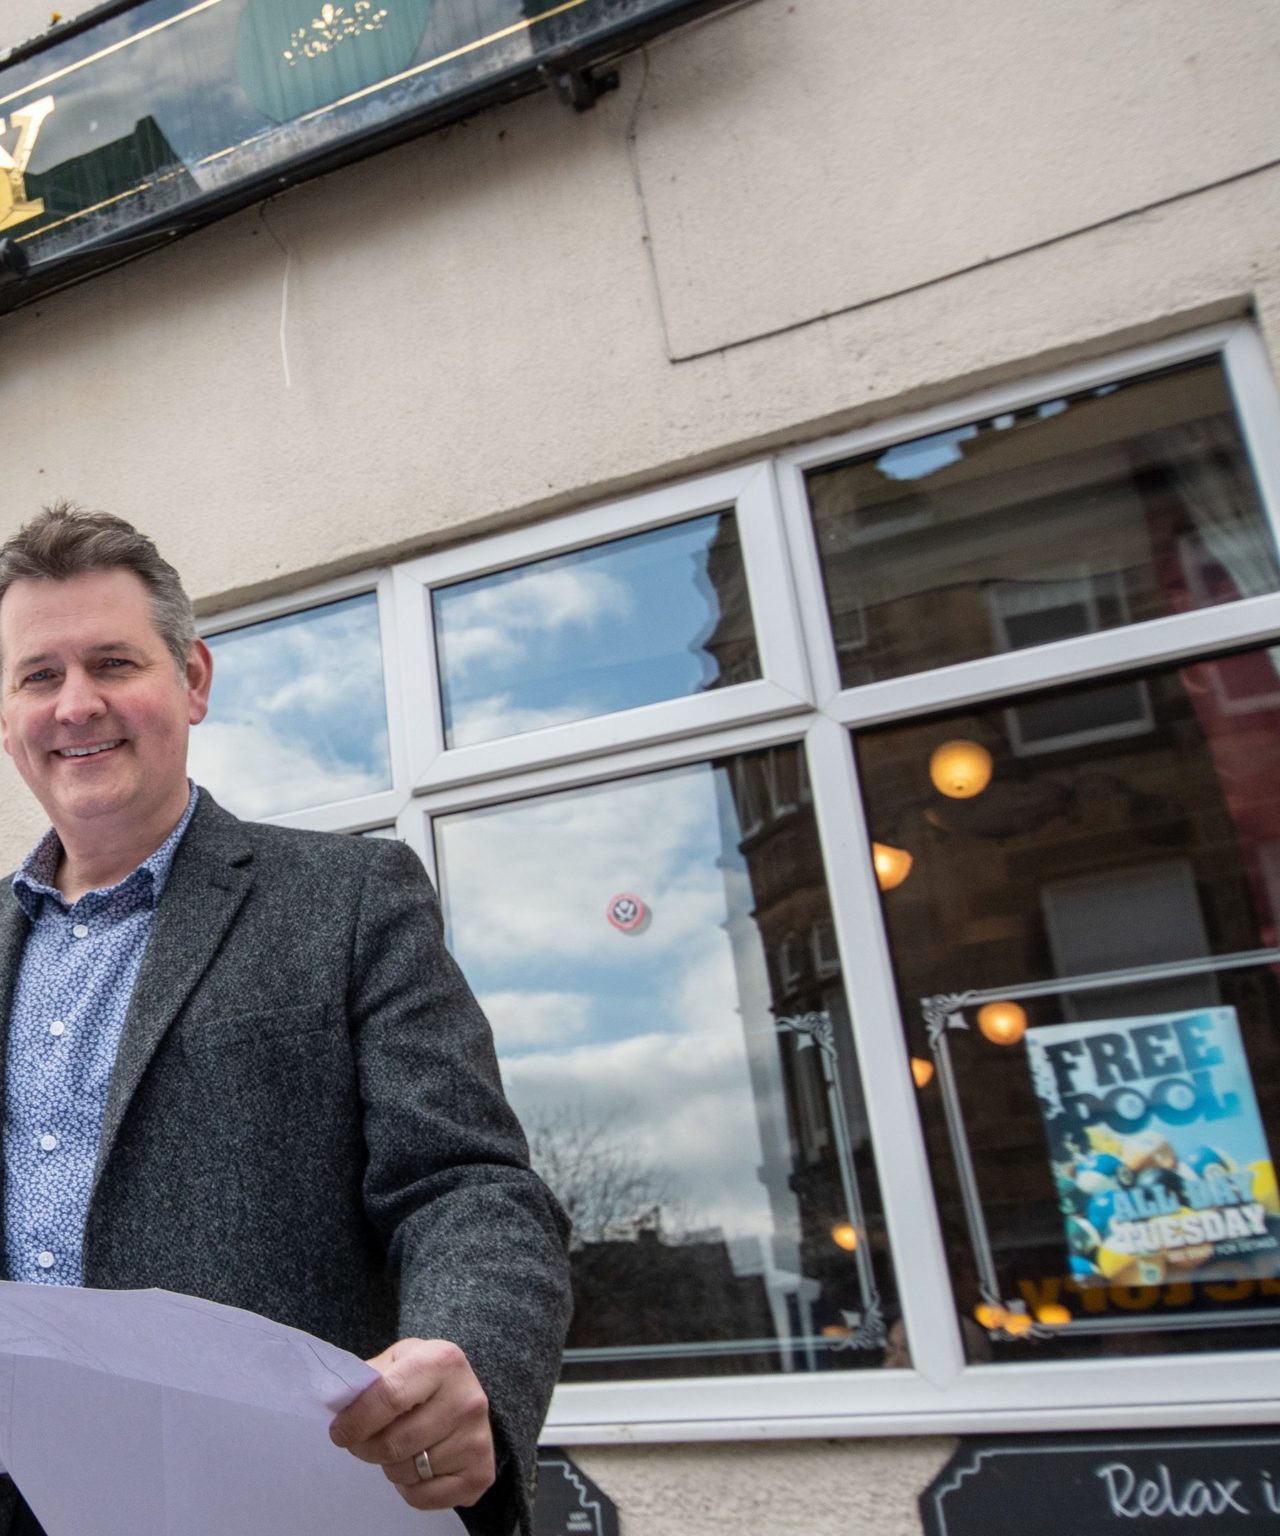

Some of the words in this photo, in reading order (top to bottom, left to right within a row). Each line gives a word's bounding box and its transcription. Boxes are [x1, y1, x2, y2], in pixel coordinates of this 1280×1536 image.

[1042, 1012, 1224, 1097] FREE
[1052, 1070, 1244, 1154] POOL
[1112, 1184, 1181, 1222] ALL
[1185, 1172, 1257, 1209] DAY
[1108, 1204, 1268, 1254] TUESDAY
[1094, 1462, 1251, 1518] Relax
